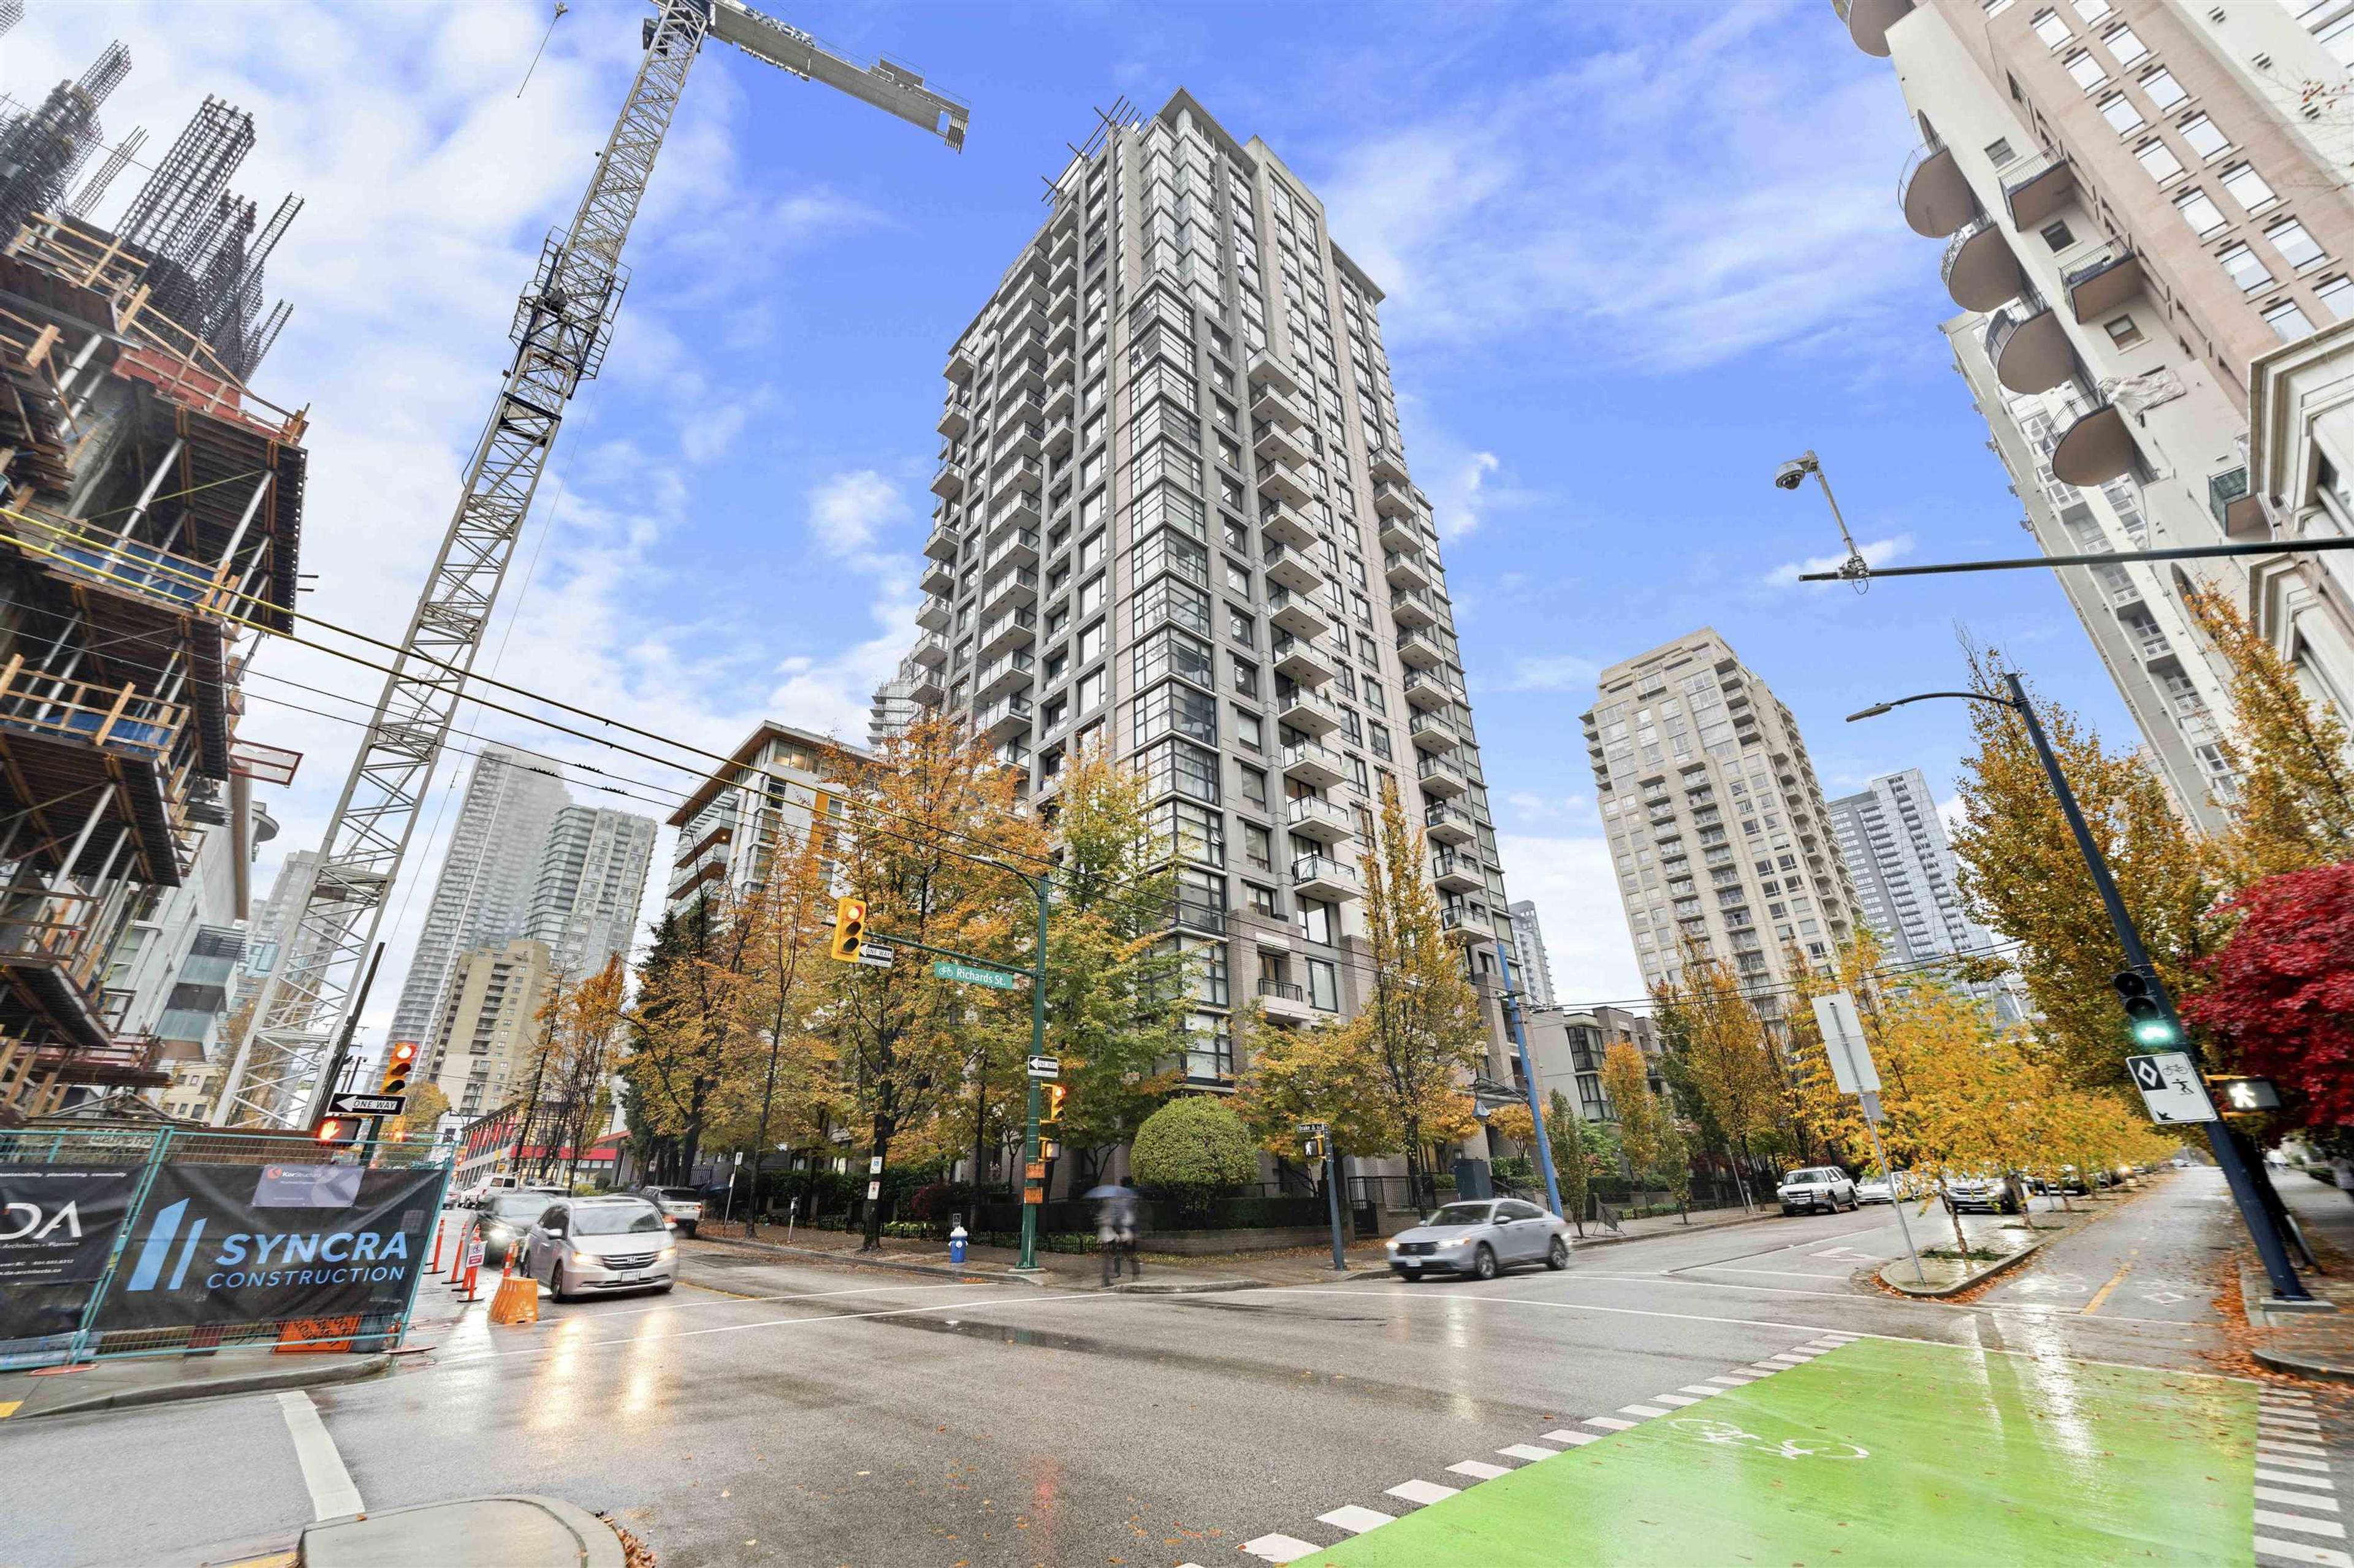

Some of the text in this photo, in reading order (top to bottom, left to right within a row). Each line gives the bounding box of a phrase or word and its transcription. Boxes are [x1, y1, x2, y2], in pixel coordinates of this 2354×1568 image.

[956, 968, 1006, 986] Richards St.
[216, 1231, 408, 1266] SYNCRA
[207, 1266, 405, 1288] CONSTRUCTION
